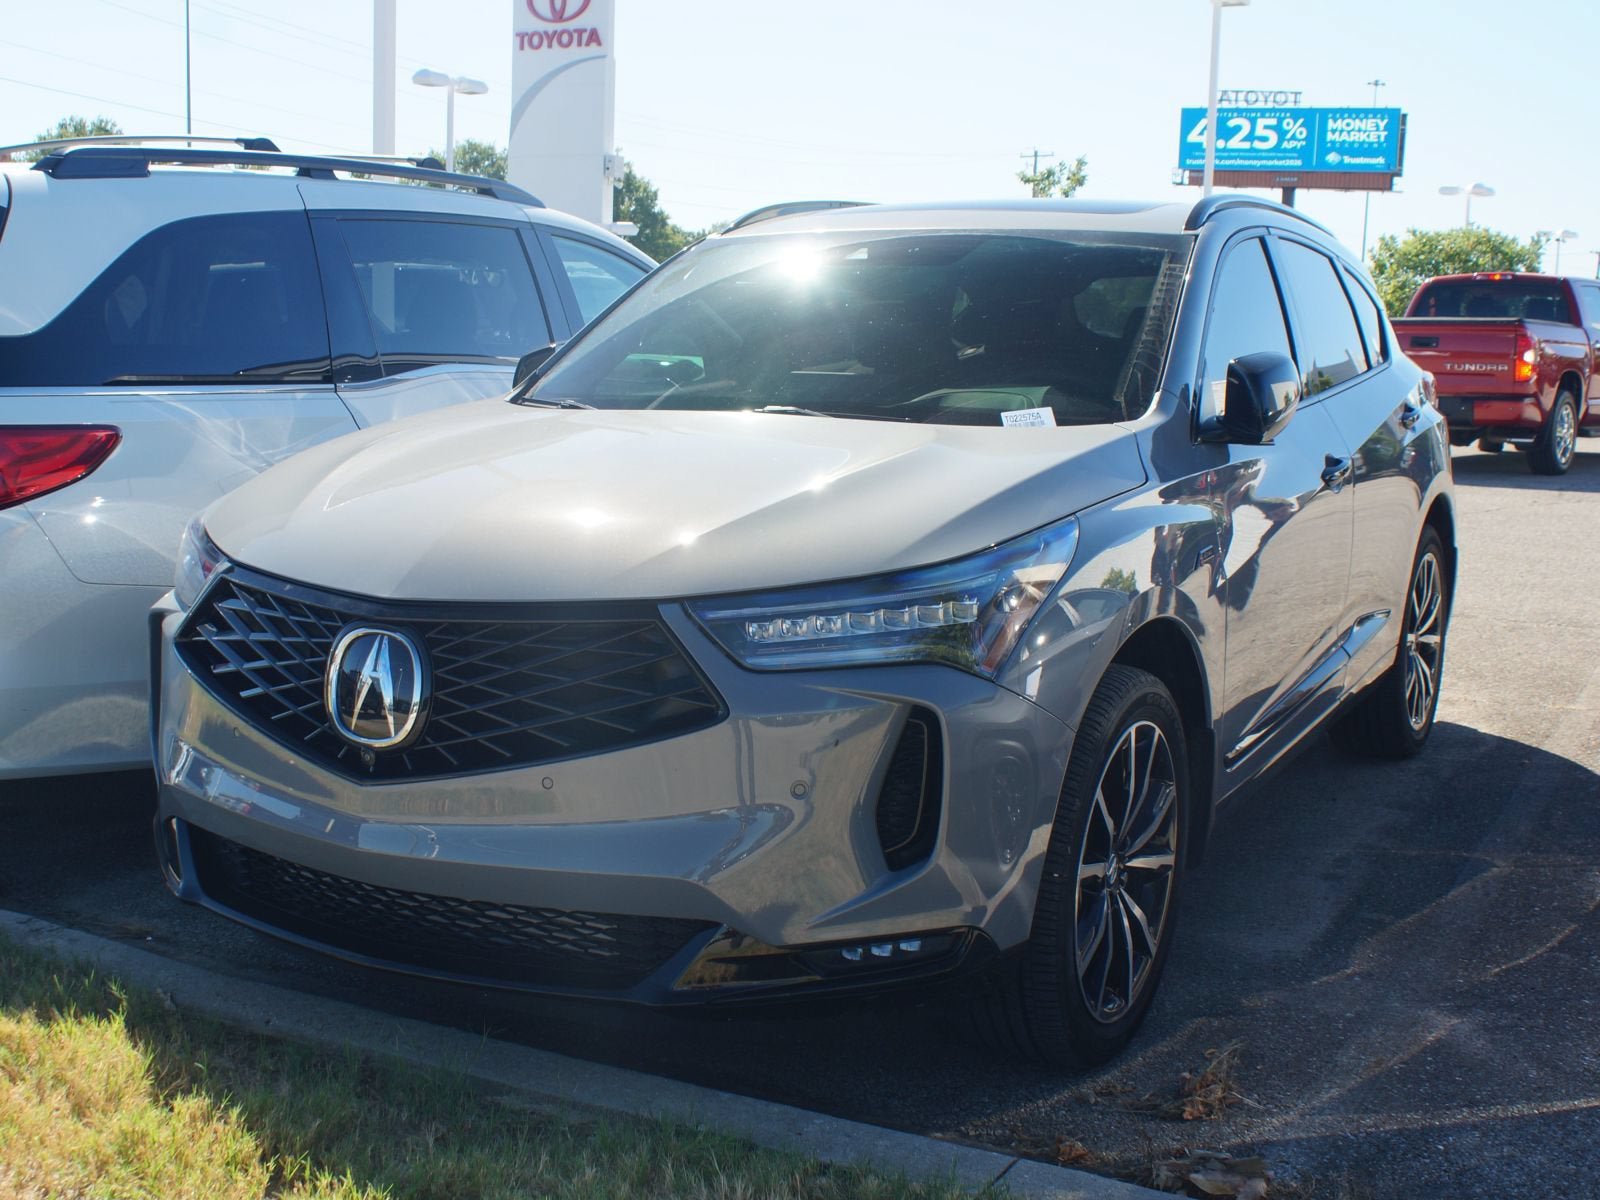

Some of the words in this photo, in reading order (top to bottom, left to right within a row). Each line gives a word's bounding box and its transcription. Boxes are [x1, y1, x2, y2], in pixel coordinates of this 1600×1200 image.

[516, 27, 602, 51] TOYOTA
[1328, 118, 1389, 131] MONEY
[1326, 131, 1388, 142] MARKET
[1343, 155, 1386, 164] Trustmark
[1444, 362, 1509, 371] TUNDRA
